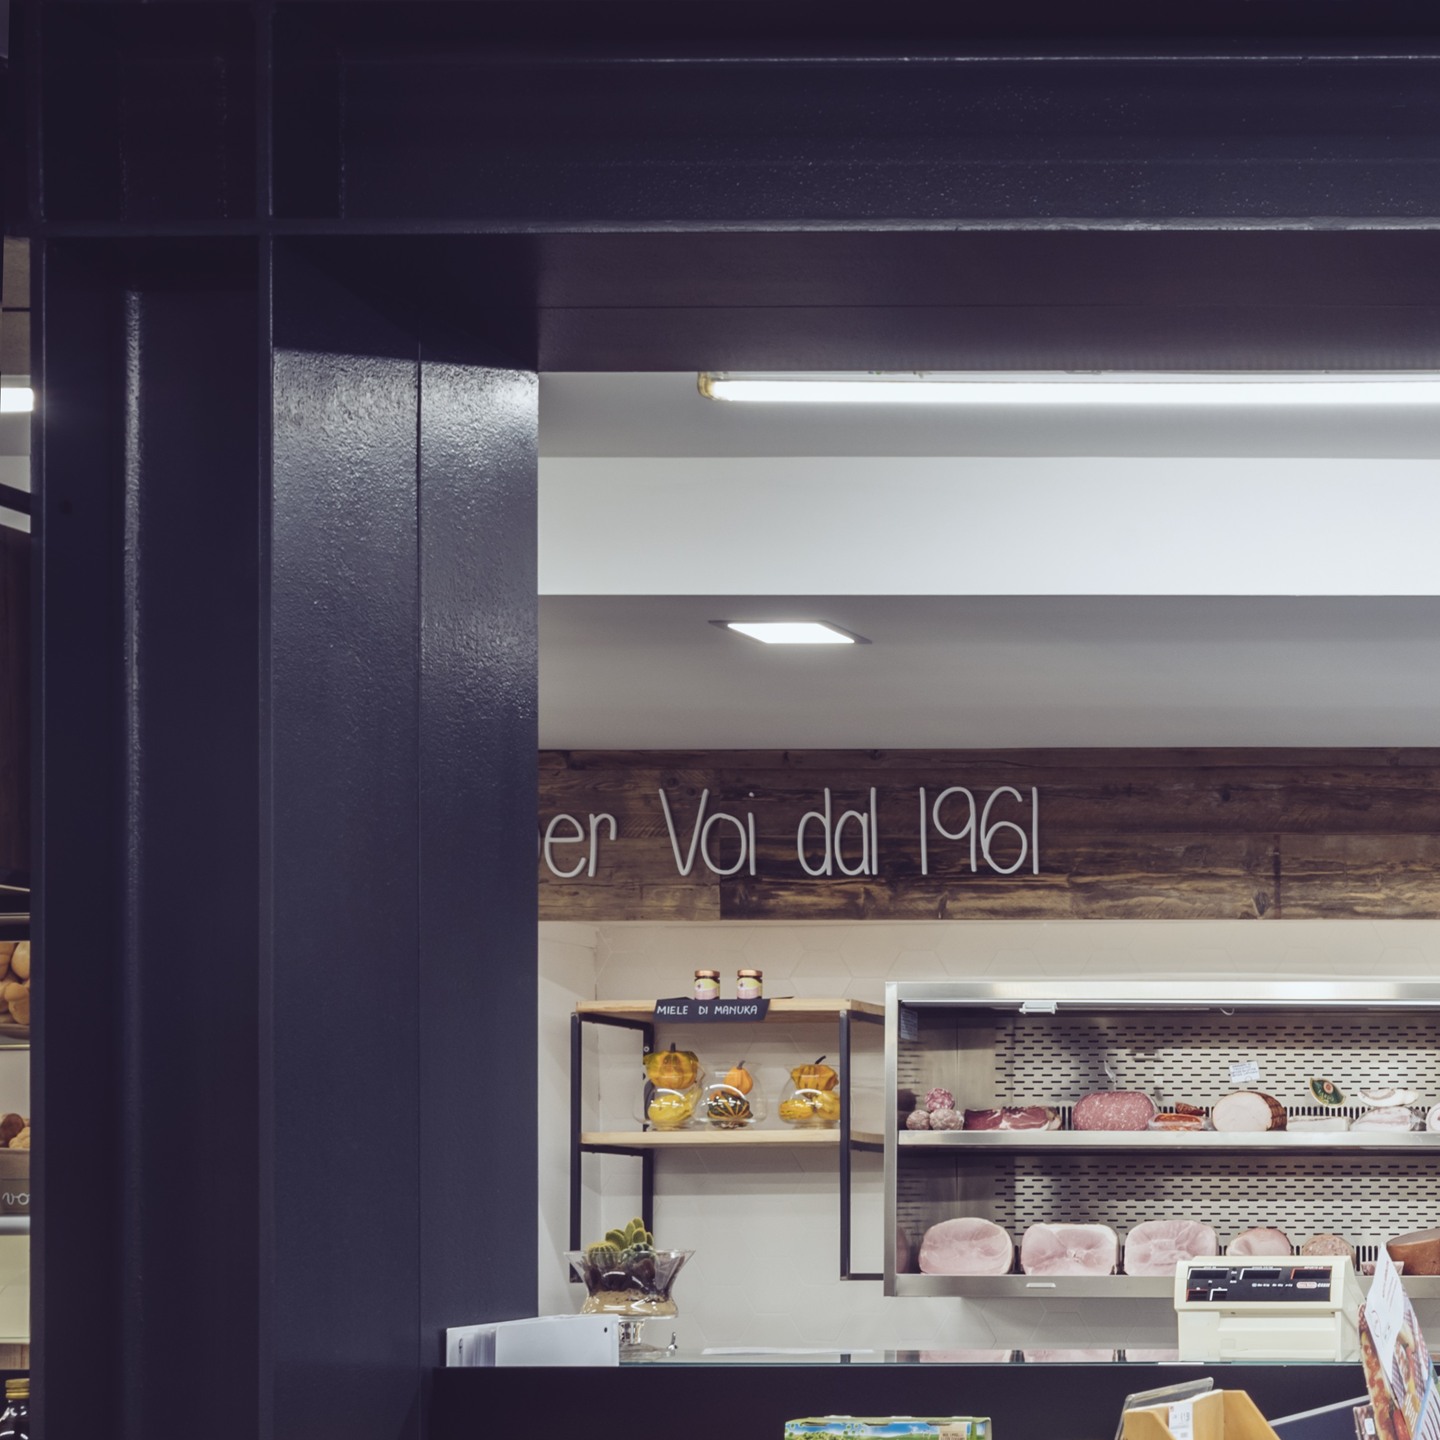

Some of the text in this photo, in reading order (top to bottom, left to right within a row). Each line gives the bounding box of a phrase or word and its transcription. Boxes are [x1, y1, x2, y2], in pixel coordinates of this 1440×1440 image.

[538, 786, 1039, 878] er Voi dal 1961
[656, 1004, 758, 1015] MIELE DI MANUKA
